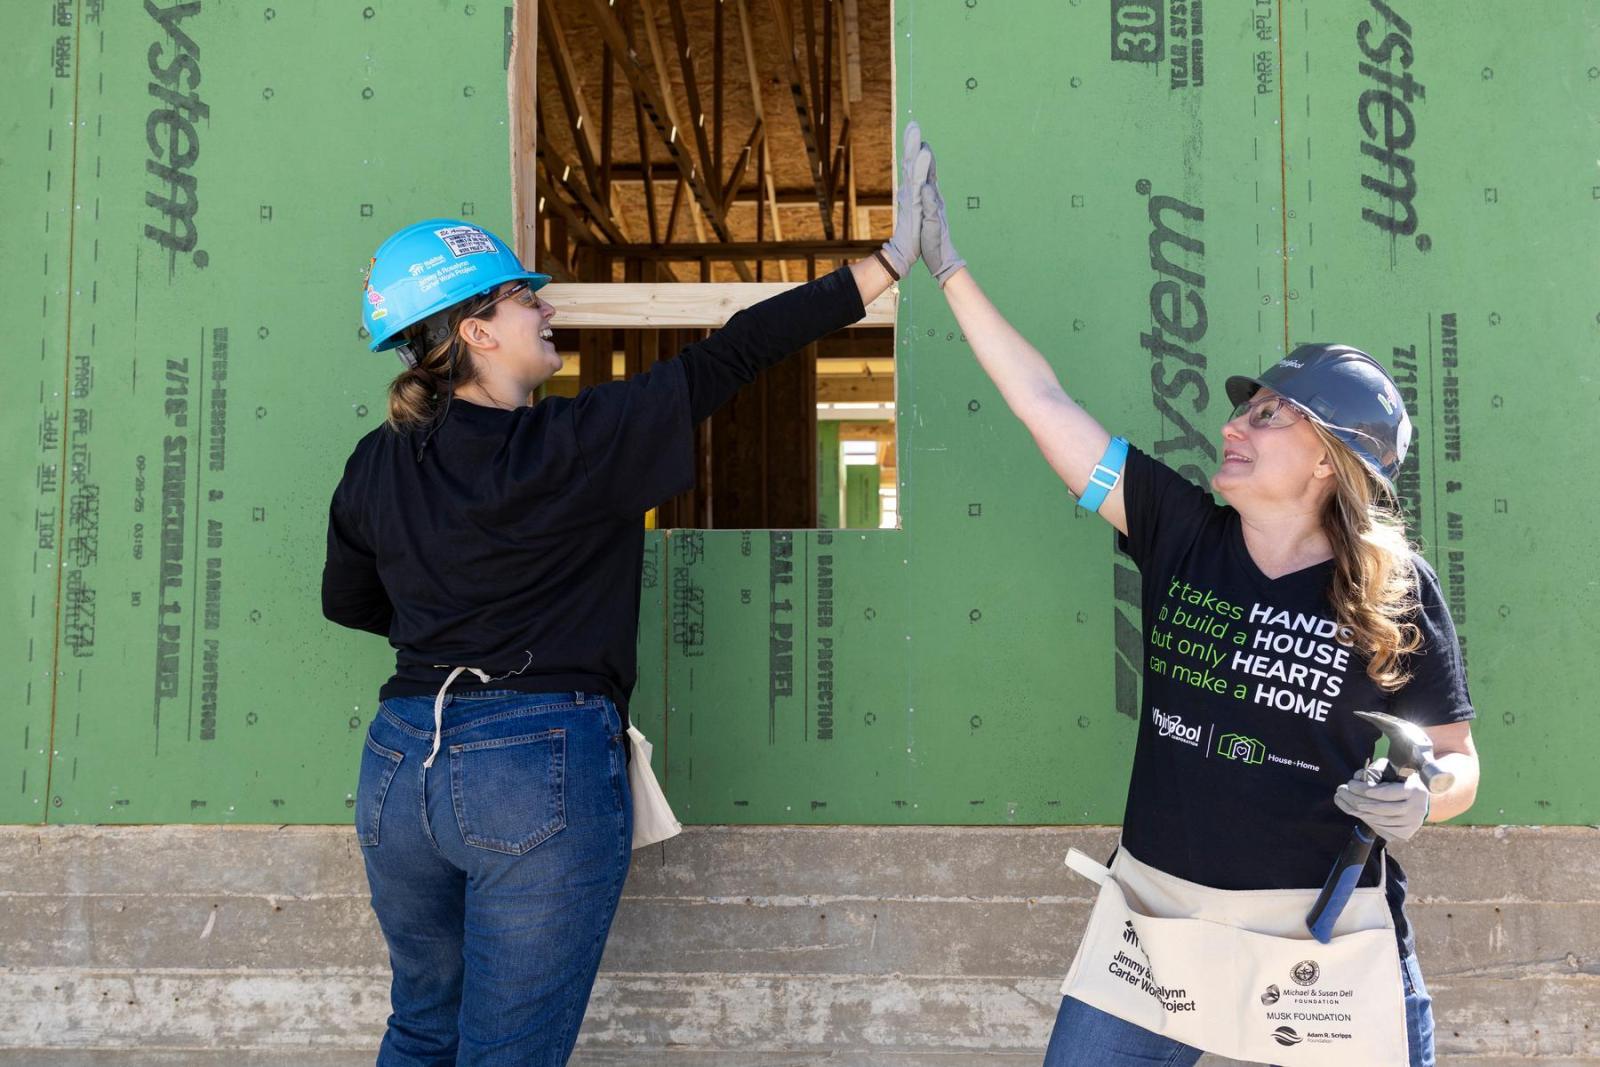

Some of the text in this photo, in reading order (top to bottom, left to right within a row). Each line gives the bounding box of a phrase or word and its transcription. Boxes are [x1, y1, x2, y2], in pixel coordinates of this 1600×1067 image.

[1116, 4, 1156, 53] 30
[1170, 45, 1187, 90] YEAR
[1191, 38, 1204, 87] LIMITED
[1257, 51, 1273, 94] PARA
[74, 355, 90, 399] PARA
[1441, 312, 1461, 462] WATER-RESISTIVE
[70, 408, 88, 484] APLICAR
[208, 489, 223, 502] &
[1446, 479, 1462, 493] &
[39, 506, 55, 550] ROLL
[207, 519, 222, 548] AIR
[1446, 511, 1464, 541] AIR
[160, 601, 182, 614] 1
[204, 558, 221, 630] BARRIER
[771, 599, 793, 613] 1
[817, 555, 833, 628] BARRIER
[1181, 583, 1244, 619] takes
[159, 623, 181, 698] PANEL
[770, 623, 793, 698] PANEL
[1151, 625, 1344, 697] but only HEARTS
[1172, 606, 1229, 639] build
[1233, 631, 1247, 645] a
[1253, 629, 1350, 672] HOUSE
[200, 639, 219, 740] PROTECTION
[817, 638, 833, 740] PROTECTION
[1150, 656, 1332, 722] can make a HOME
[1113, 950, 1145, 976] Jimmy
[1108, 962, 1141, 986] Carter
[1159, 997, 1196, 1013] roject
[1318, 989, 1338, 997] Susan
[1340, 990, 1353, 998] Dell
[1266, 1012, 1351, 1021] MUSK FOUNDATION
